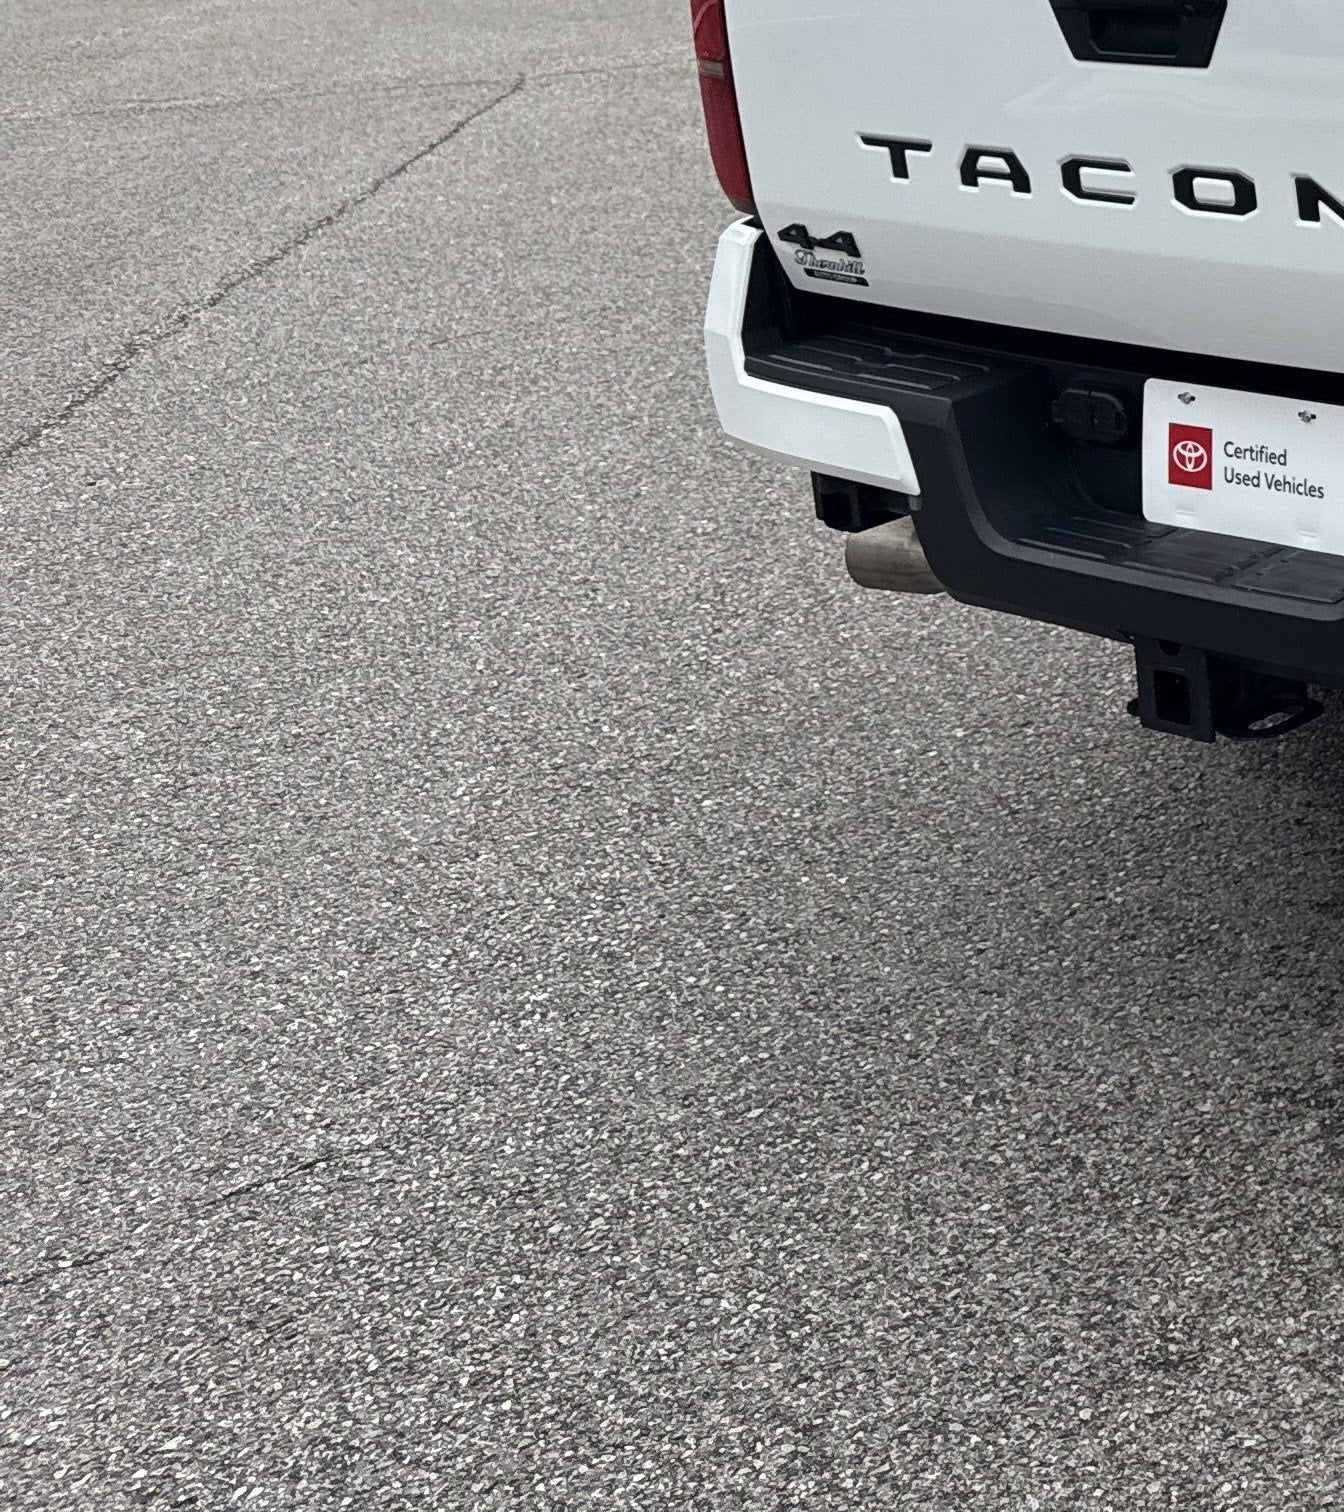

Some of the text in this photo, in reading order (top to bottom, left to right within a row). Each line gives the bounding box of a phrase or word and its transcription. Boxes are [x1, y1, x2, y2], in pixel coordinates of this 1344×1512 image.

[1223, 440, 1287, 467] Certified
[1223, 466, 1325, 499] Used Vehicles
